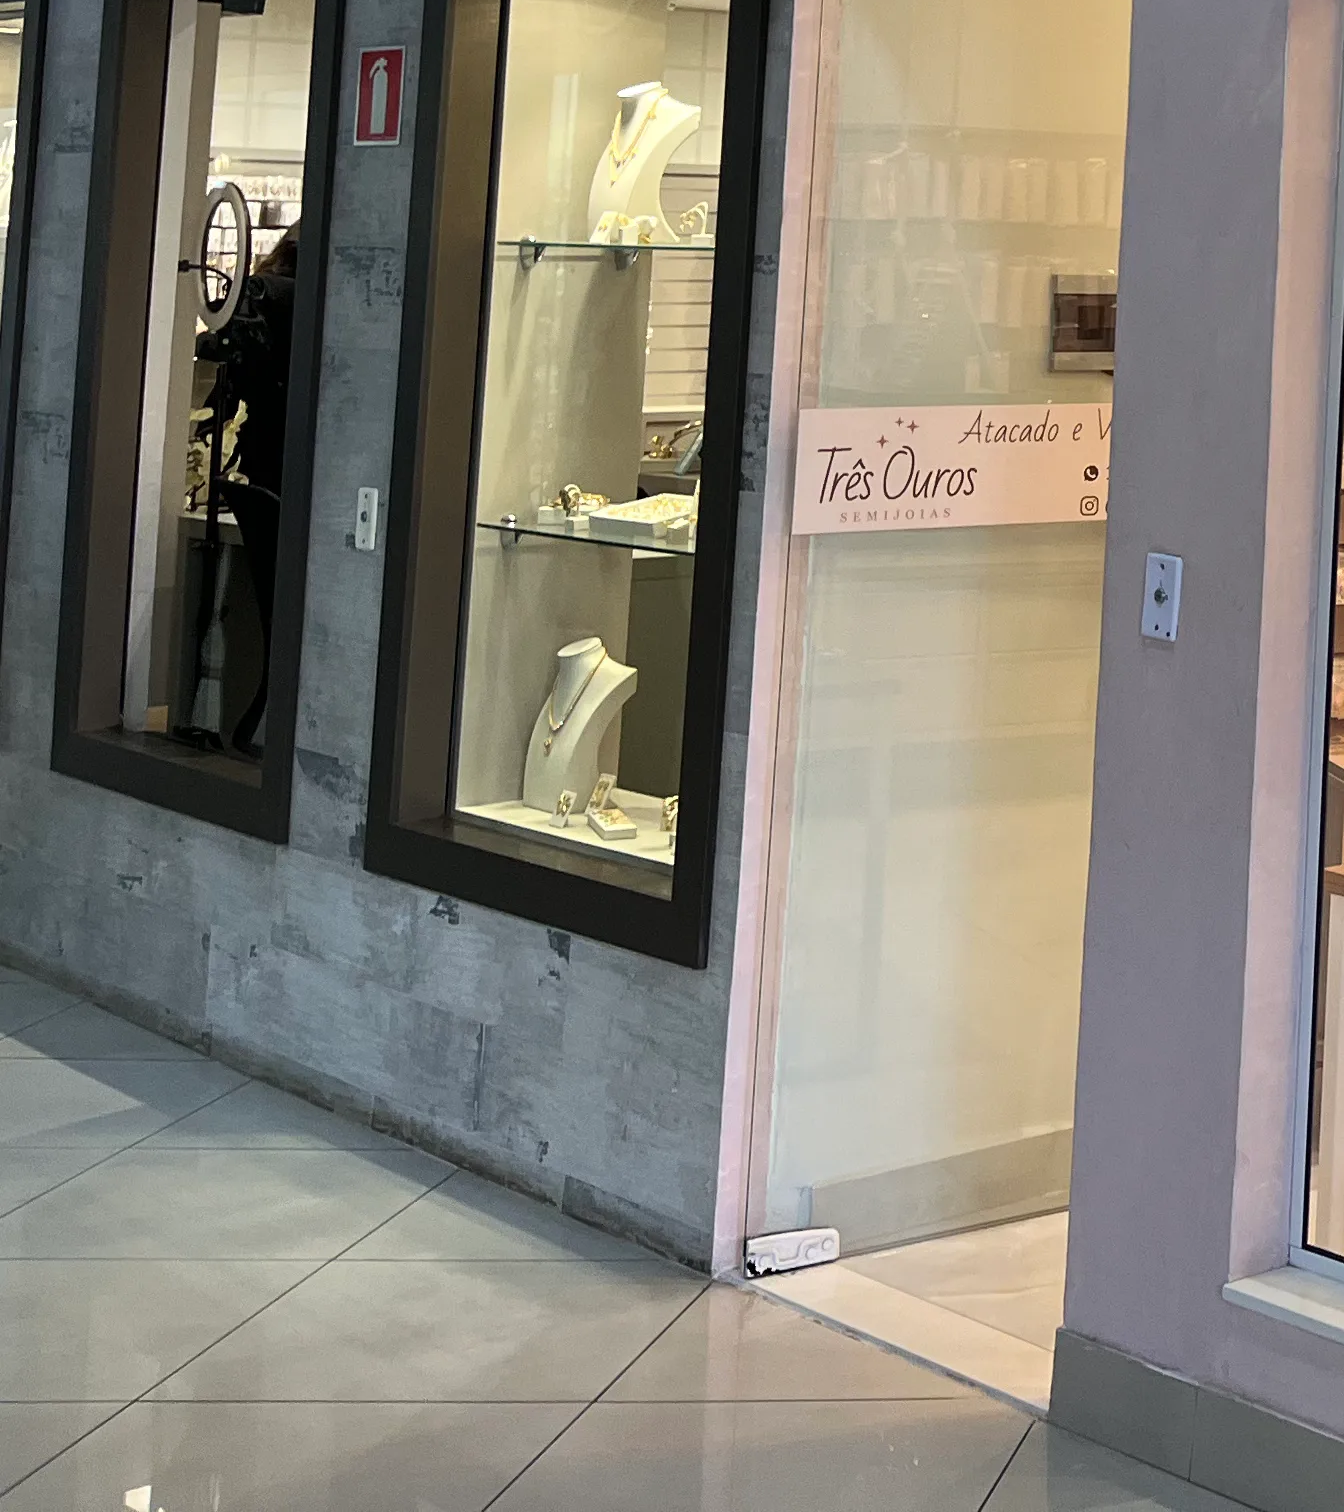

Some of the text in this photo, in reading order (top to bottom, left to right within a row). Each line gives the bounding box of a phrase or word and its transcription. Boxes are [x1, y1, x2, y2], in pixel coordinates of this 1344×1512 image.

[957, 409, 1060, 444] Atacado
[1072, 422, 1083, 442] e
[817, 445, 978, 504] Três Ouros
[838, 506, 952, 524] SEMIJOIAS
